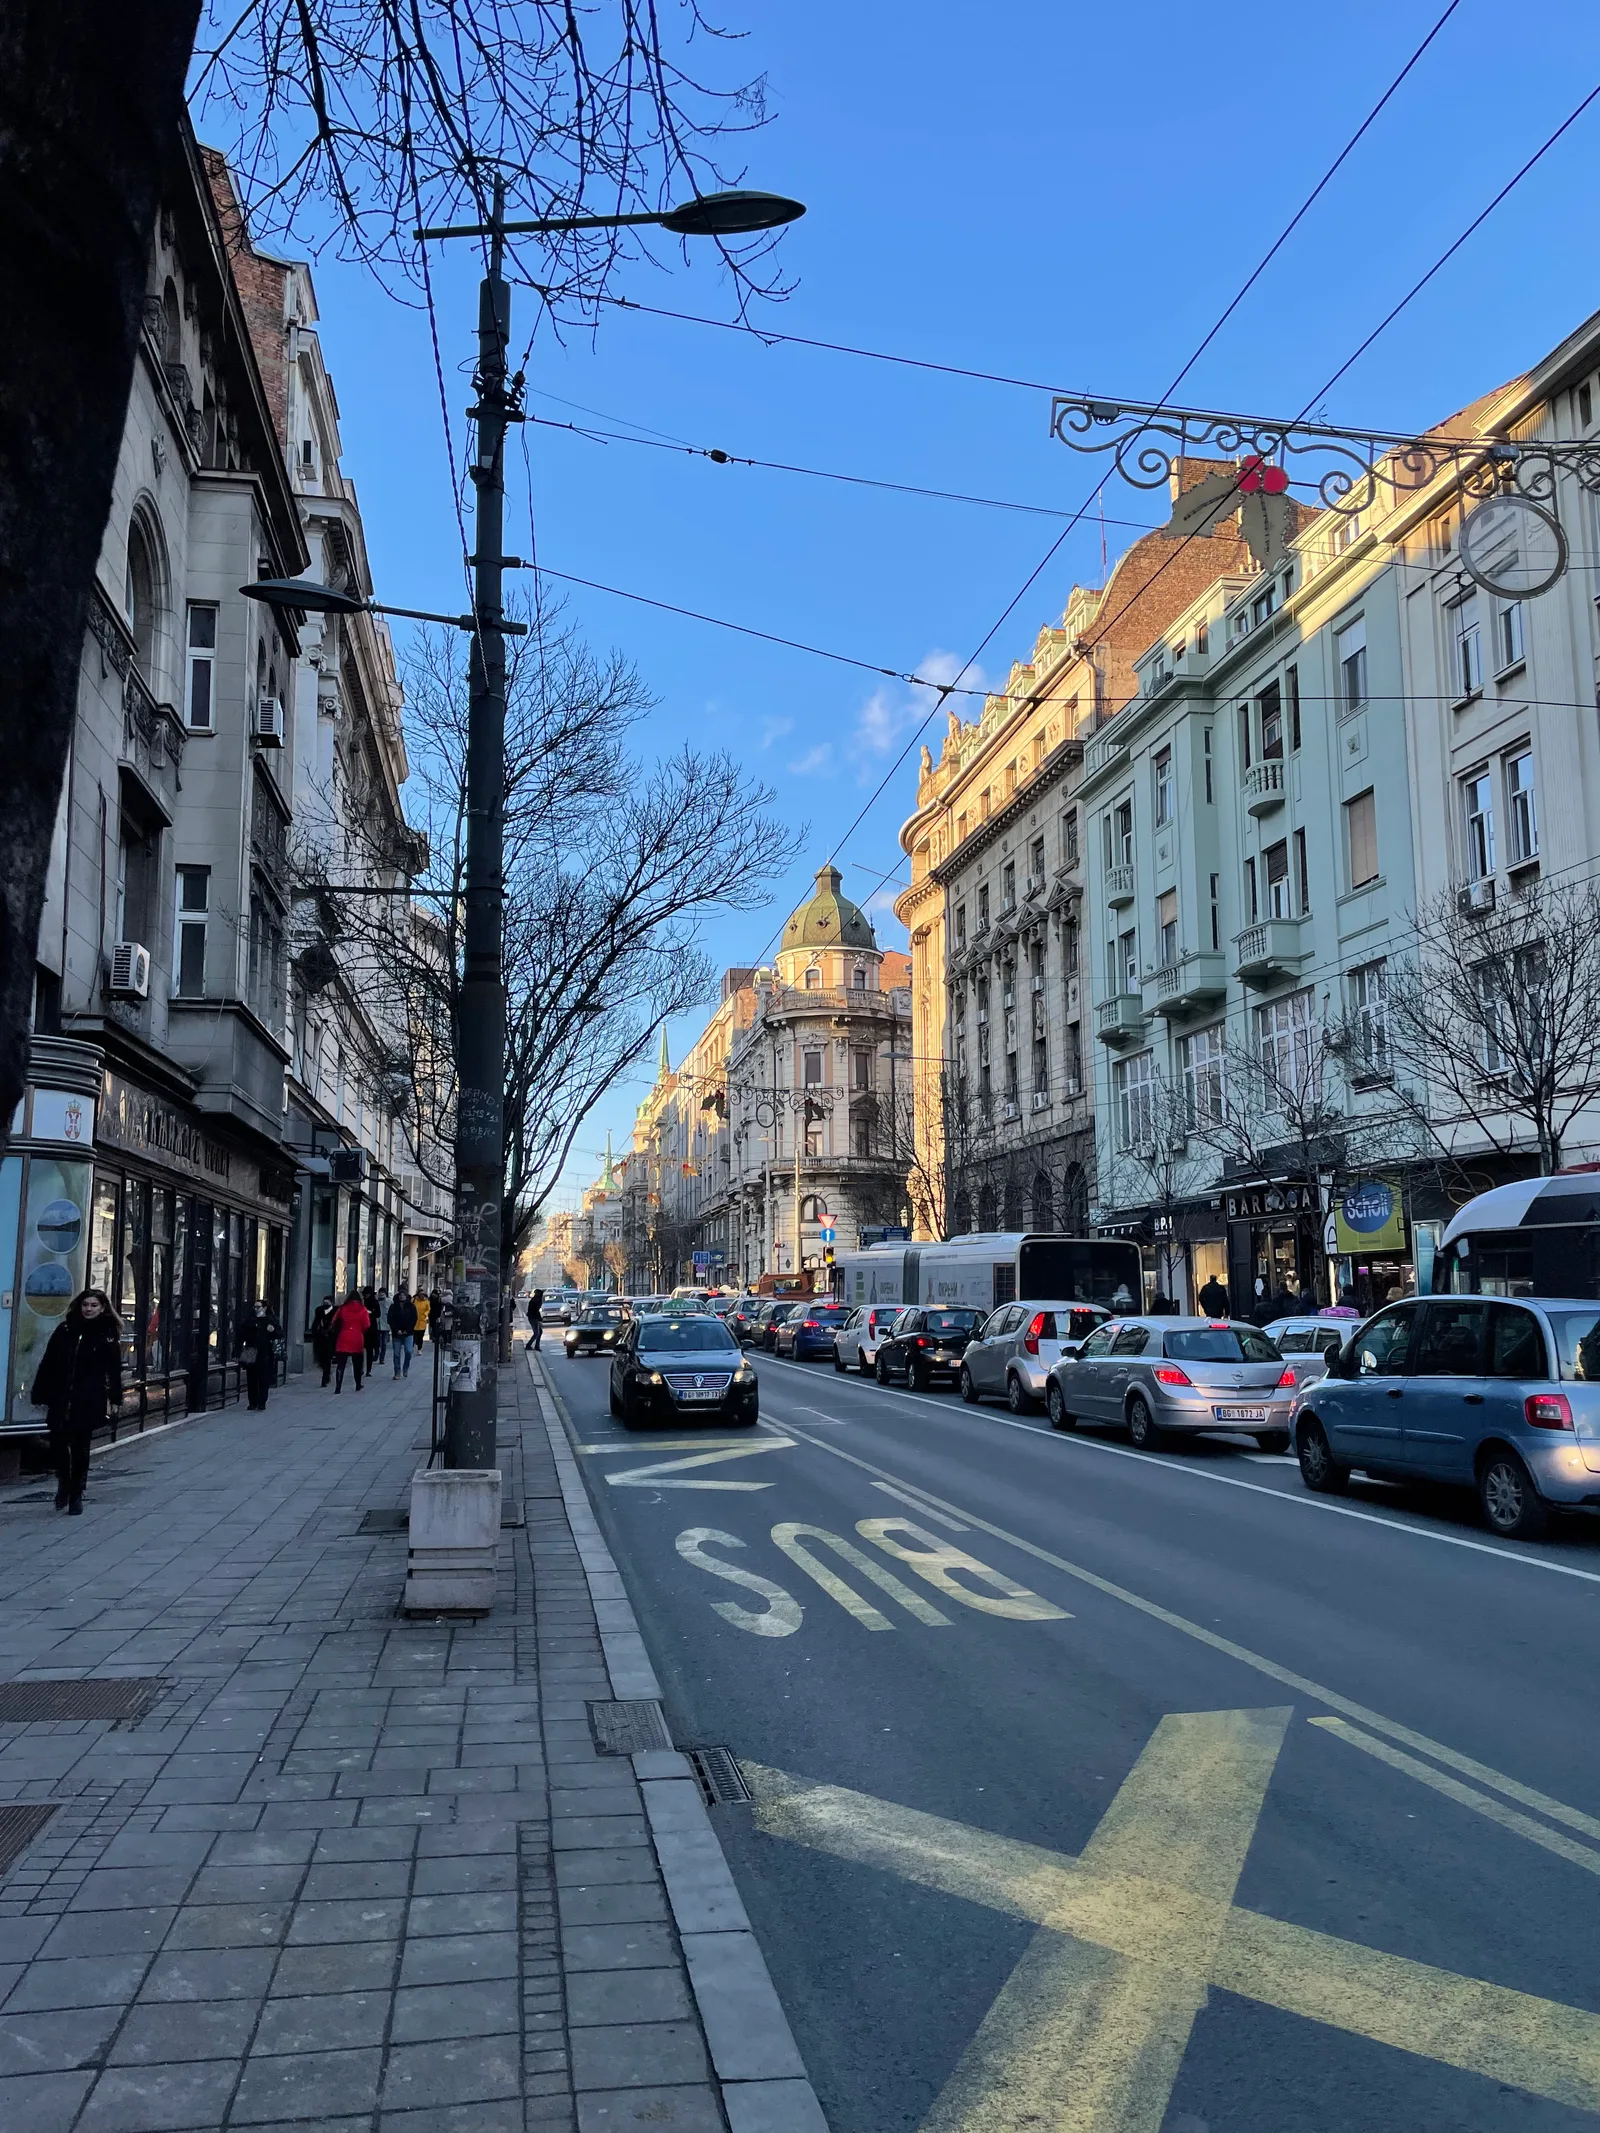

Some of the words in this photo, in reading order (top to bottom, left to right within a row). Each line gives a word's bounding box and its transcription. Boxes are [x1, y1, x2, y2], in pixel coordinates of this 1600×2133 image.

[1222, 1409, 1232, 1418] BG
[1236, 1409, 1253, 1418] 1872
[1255, 1409, 1264, 1418] JA
[675, 1517, 1076, 1637] BUS
